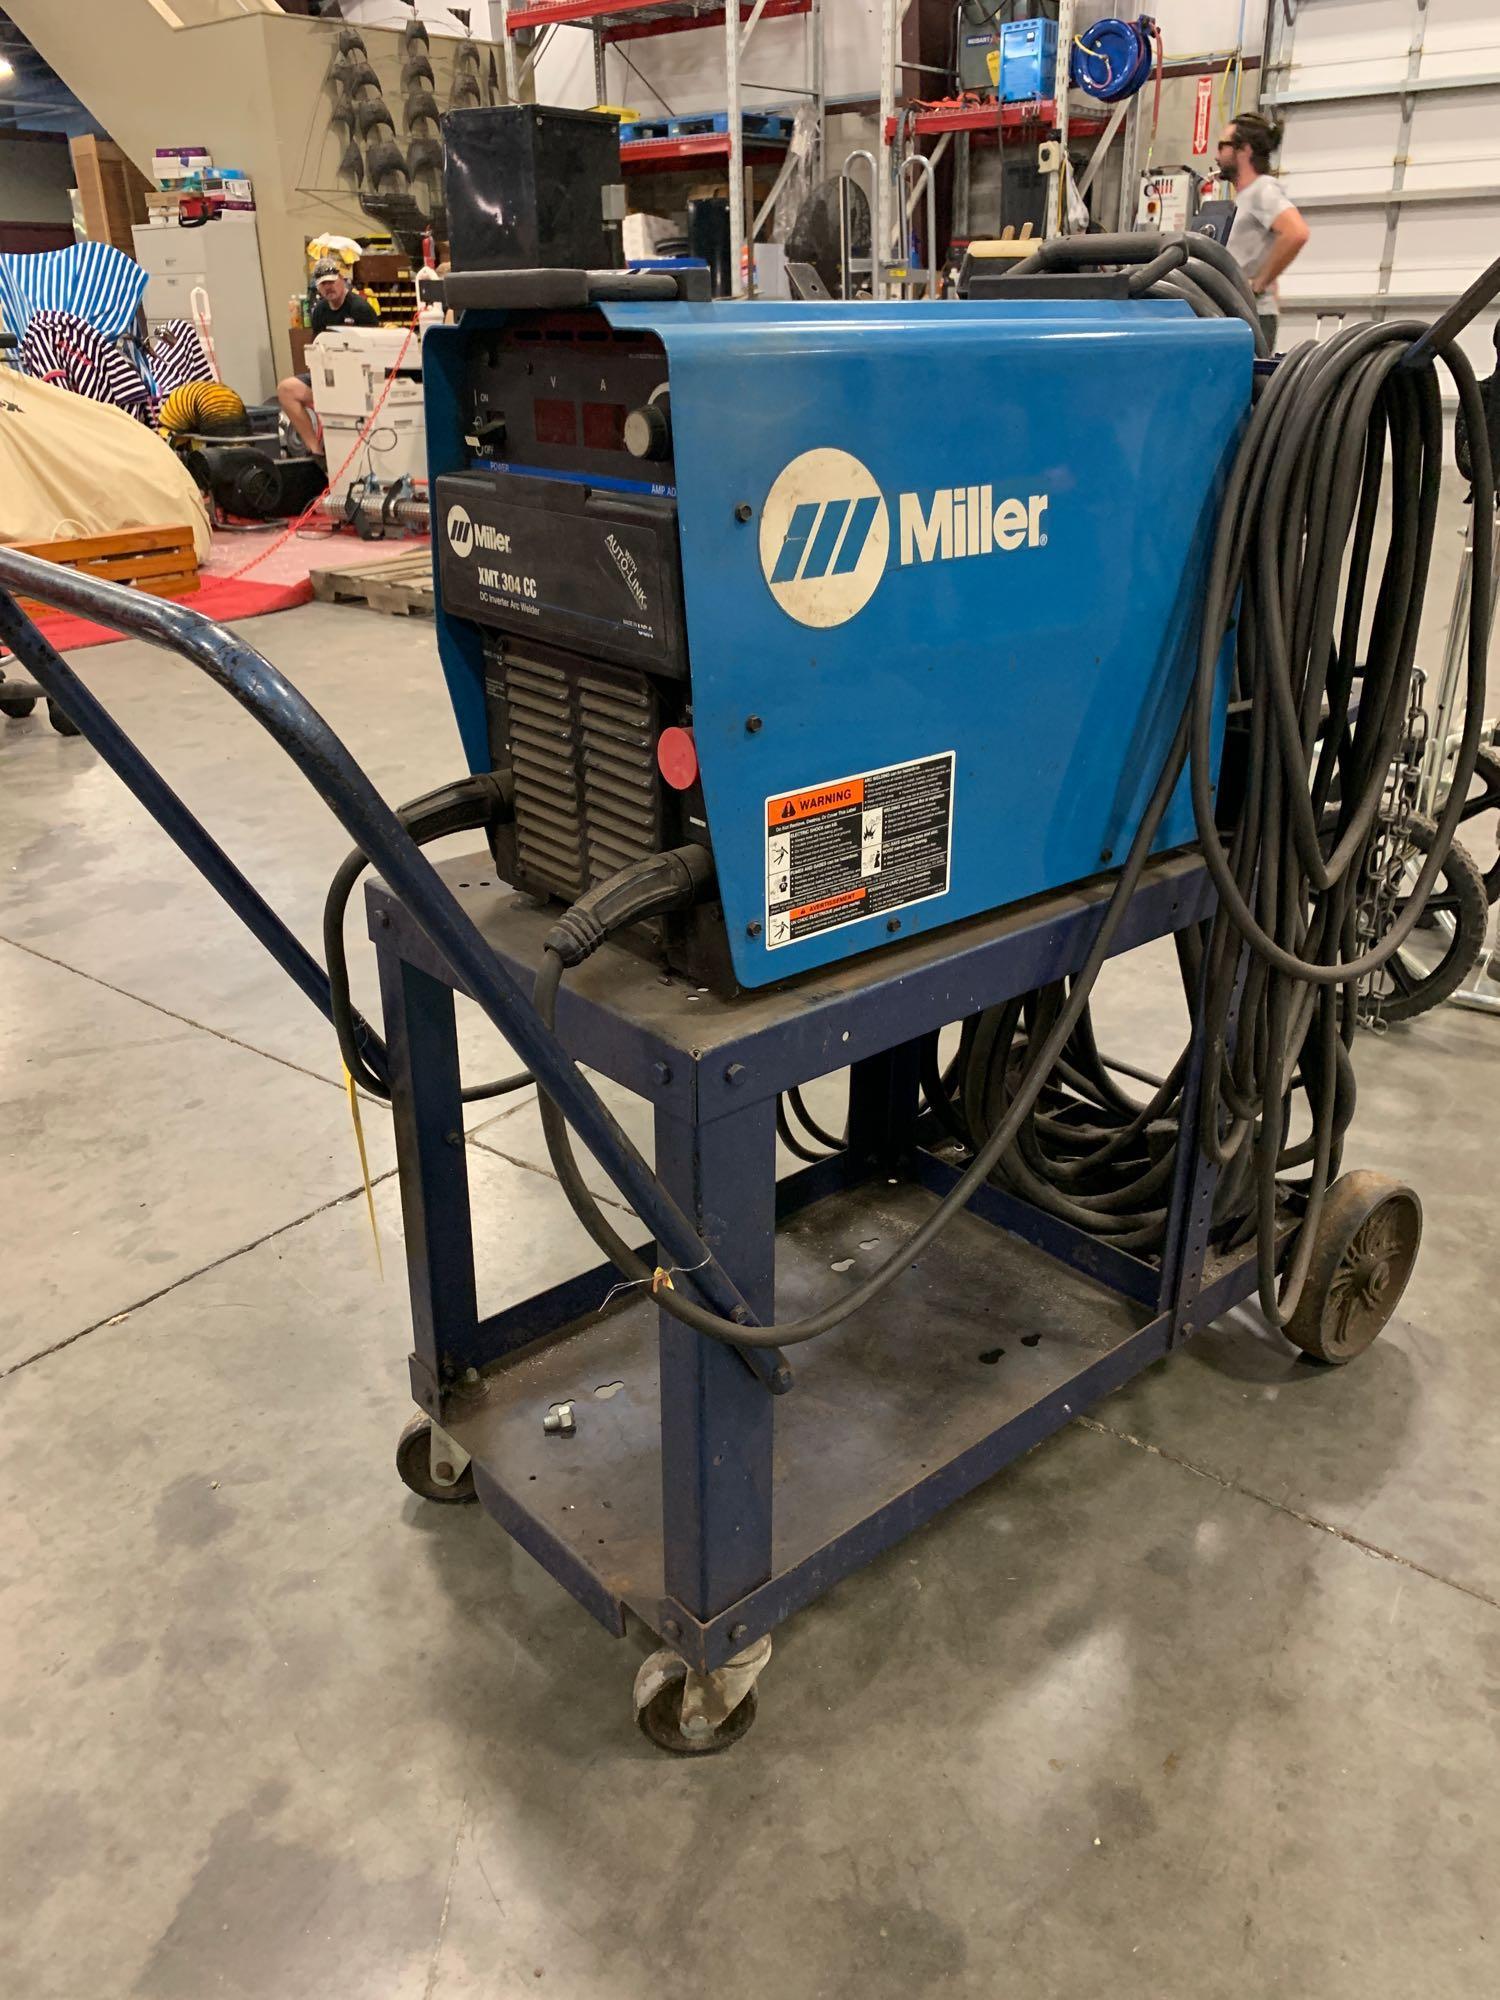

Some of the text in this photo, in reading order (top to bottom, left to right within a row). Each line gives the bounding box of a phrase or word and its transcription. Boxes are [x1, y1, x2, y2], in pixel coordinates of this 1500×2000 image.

[550, 376, 556, 388] V
[600, 379, 606, 391] A
[480, 393, 489, 402] ON
[490, 461, 510, 472] POWER
[651, 483, 665, 495] AMP
[899, 484, 1048, 565] Miller
[474, 523, 511, 553] Miller
[606, 533, 648, 604] AUTO-LINK
[624, 548, 638, 573] WITH
[478, 566, 537, 598] XMT 304 CC
[480, 591, 540, 616] DC Inverter Arc Welder
[800, 789, 851, 811] WARNING
[809, 893, 855, 911] AVERTISSEMENT
